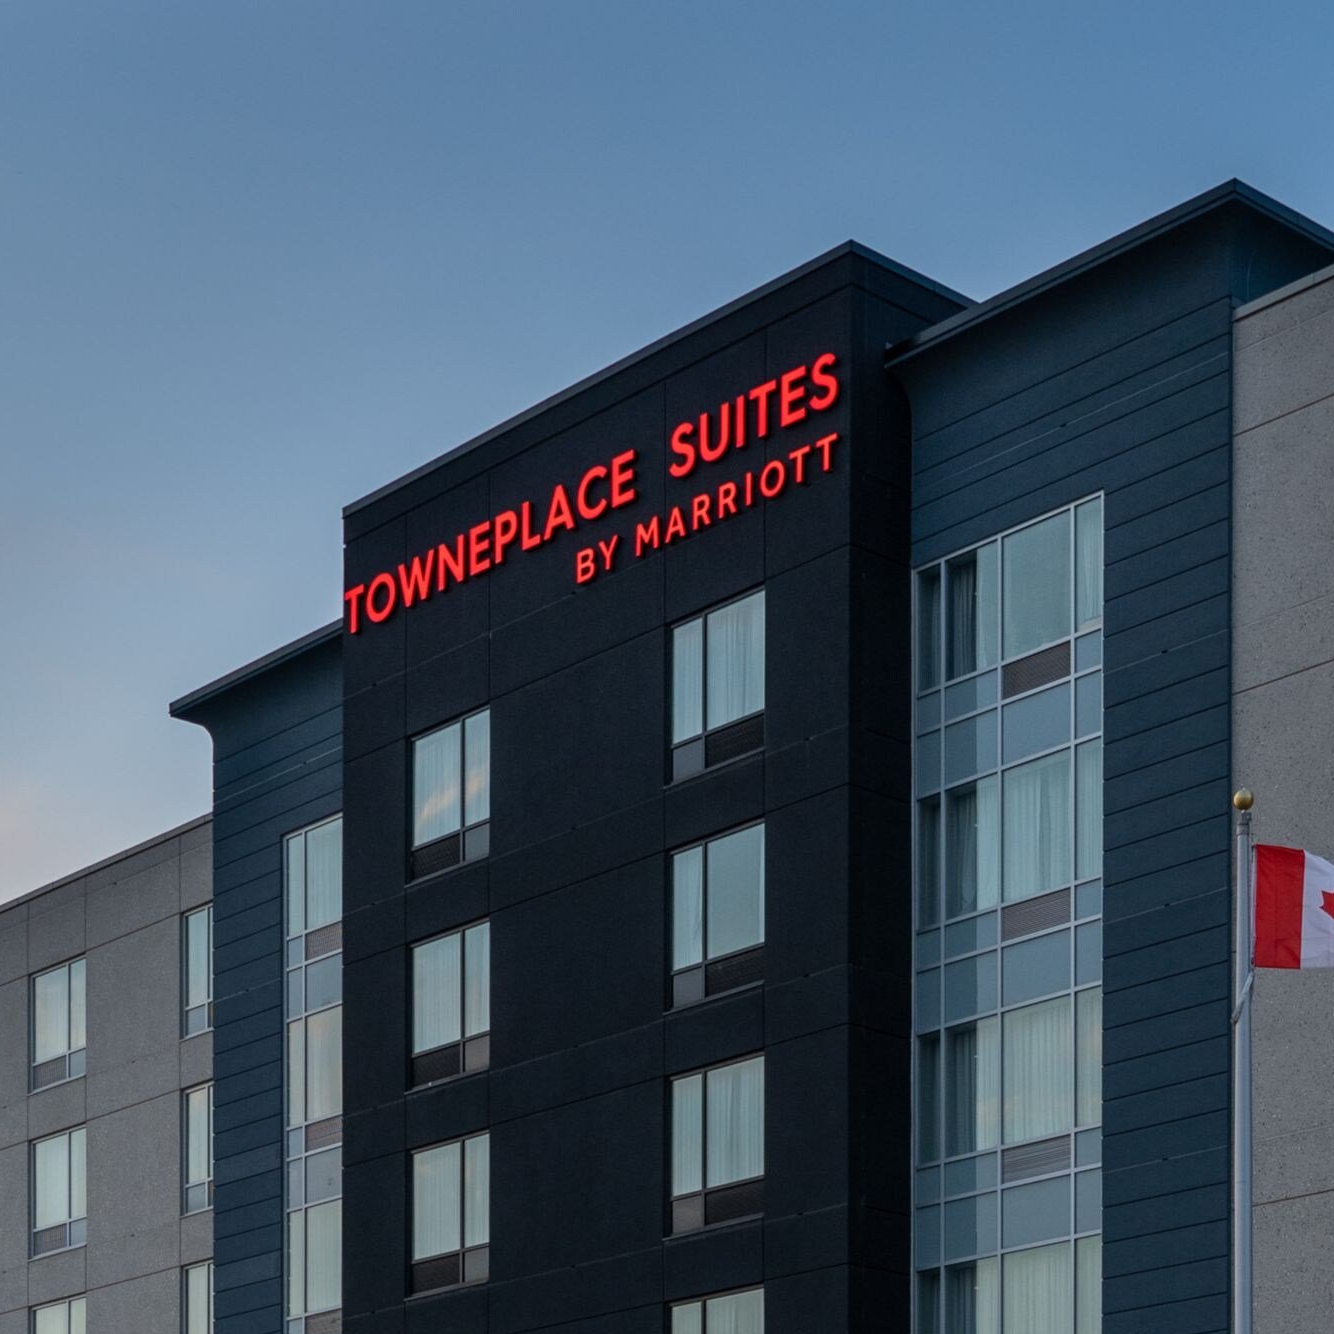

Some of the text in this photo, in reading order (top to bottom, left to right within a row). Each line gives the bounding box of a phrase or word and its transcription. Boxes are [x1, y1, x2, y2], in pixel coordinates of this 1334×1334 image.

[343, 352, 839, 634] TOWNEPLACE SUITES
[575, 432, 839, 584] BY MARRIOTT
